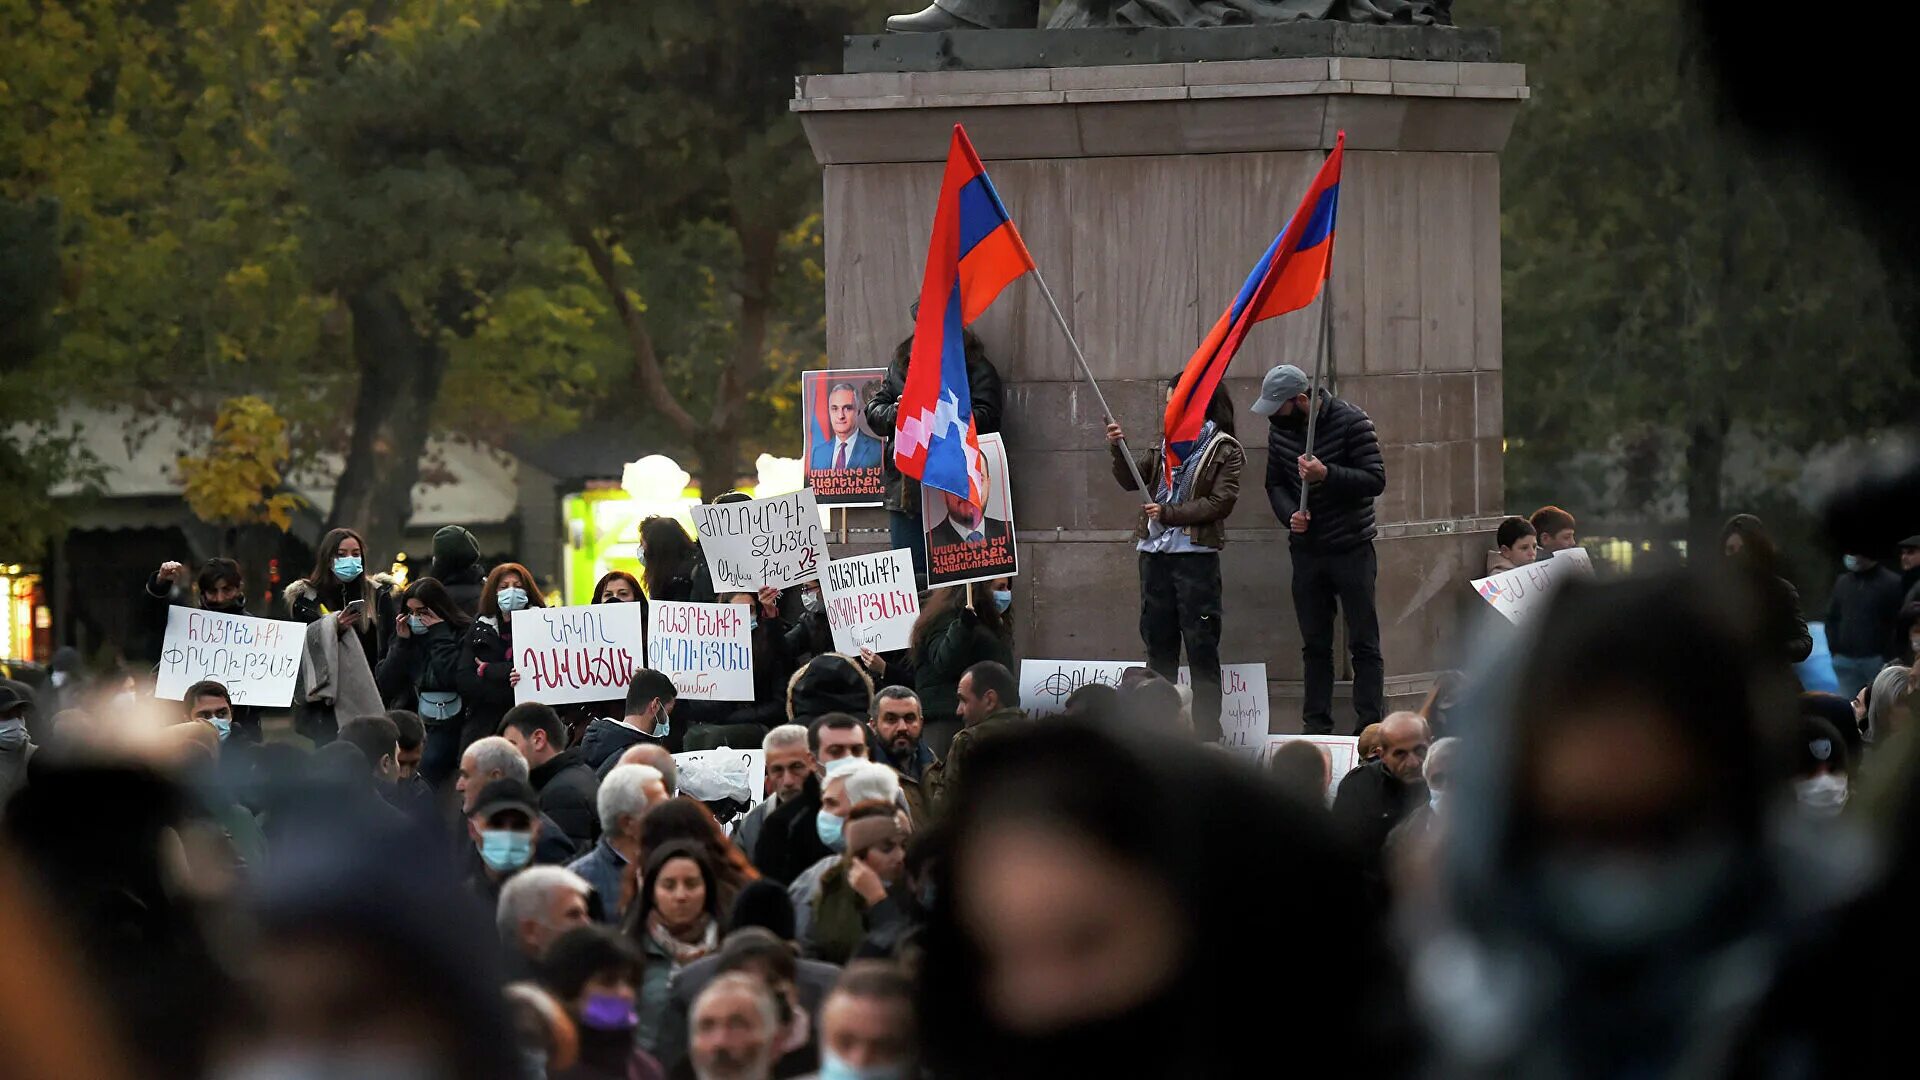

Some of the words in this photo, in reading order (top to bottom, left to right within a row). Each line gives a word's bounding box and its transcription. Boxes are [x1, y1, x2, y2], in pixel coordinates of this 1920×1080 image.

[809, 476, 881, 488] ՀԱՅՐԵՆԻՔԻ
[866, 467, 881, 477] ԵՄ
[813, 486, 885, 496] ԱՎԱՃԱՆՈՒԹՅԱՆԸ
[699, 494, 805, 538] ԺՈՂՈՎՐԴԻ
[932, 546, 1008, 567] ՀԱՅՐԵՆԻՔԻ
[991, 536, 1007, 547] ԵՄ
[658, 604, 742, 638] ՀԱՅՐԵՆԻՔԻ
[826, 590, 916, 631] ՓՐԿՈՒԹՅԱՆ
[188, 612, 284, 649] ՀԱՅՐԵՆԻՔԻ
[543, 611, 616, 645] ՆԻԿՈԼ
[163, 643, 296, 681] ՓՐԿՈՒԹՅԱՆ
[649, 635, 750, 673] ՓՐԿՈՒԹՅԱՆ
